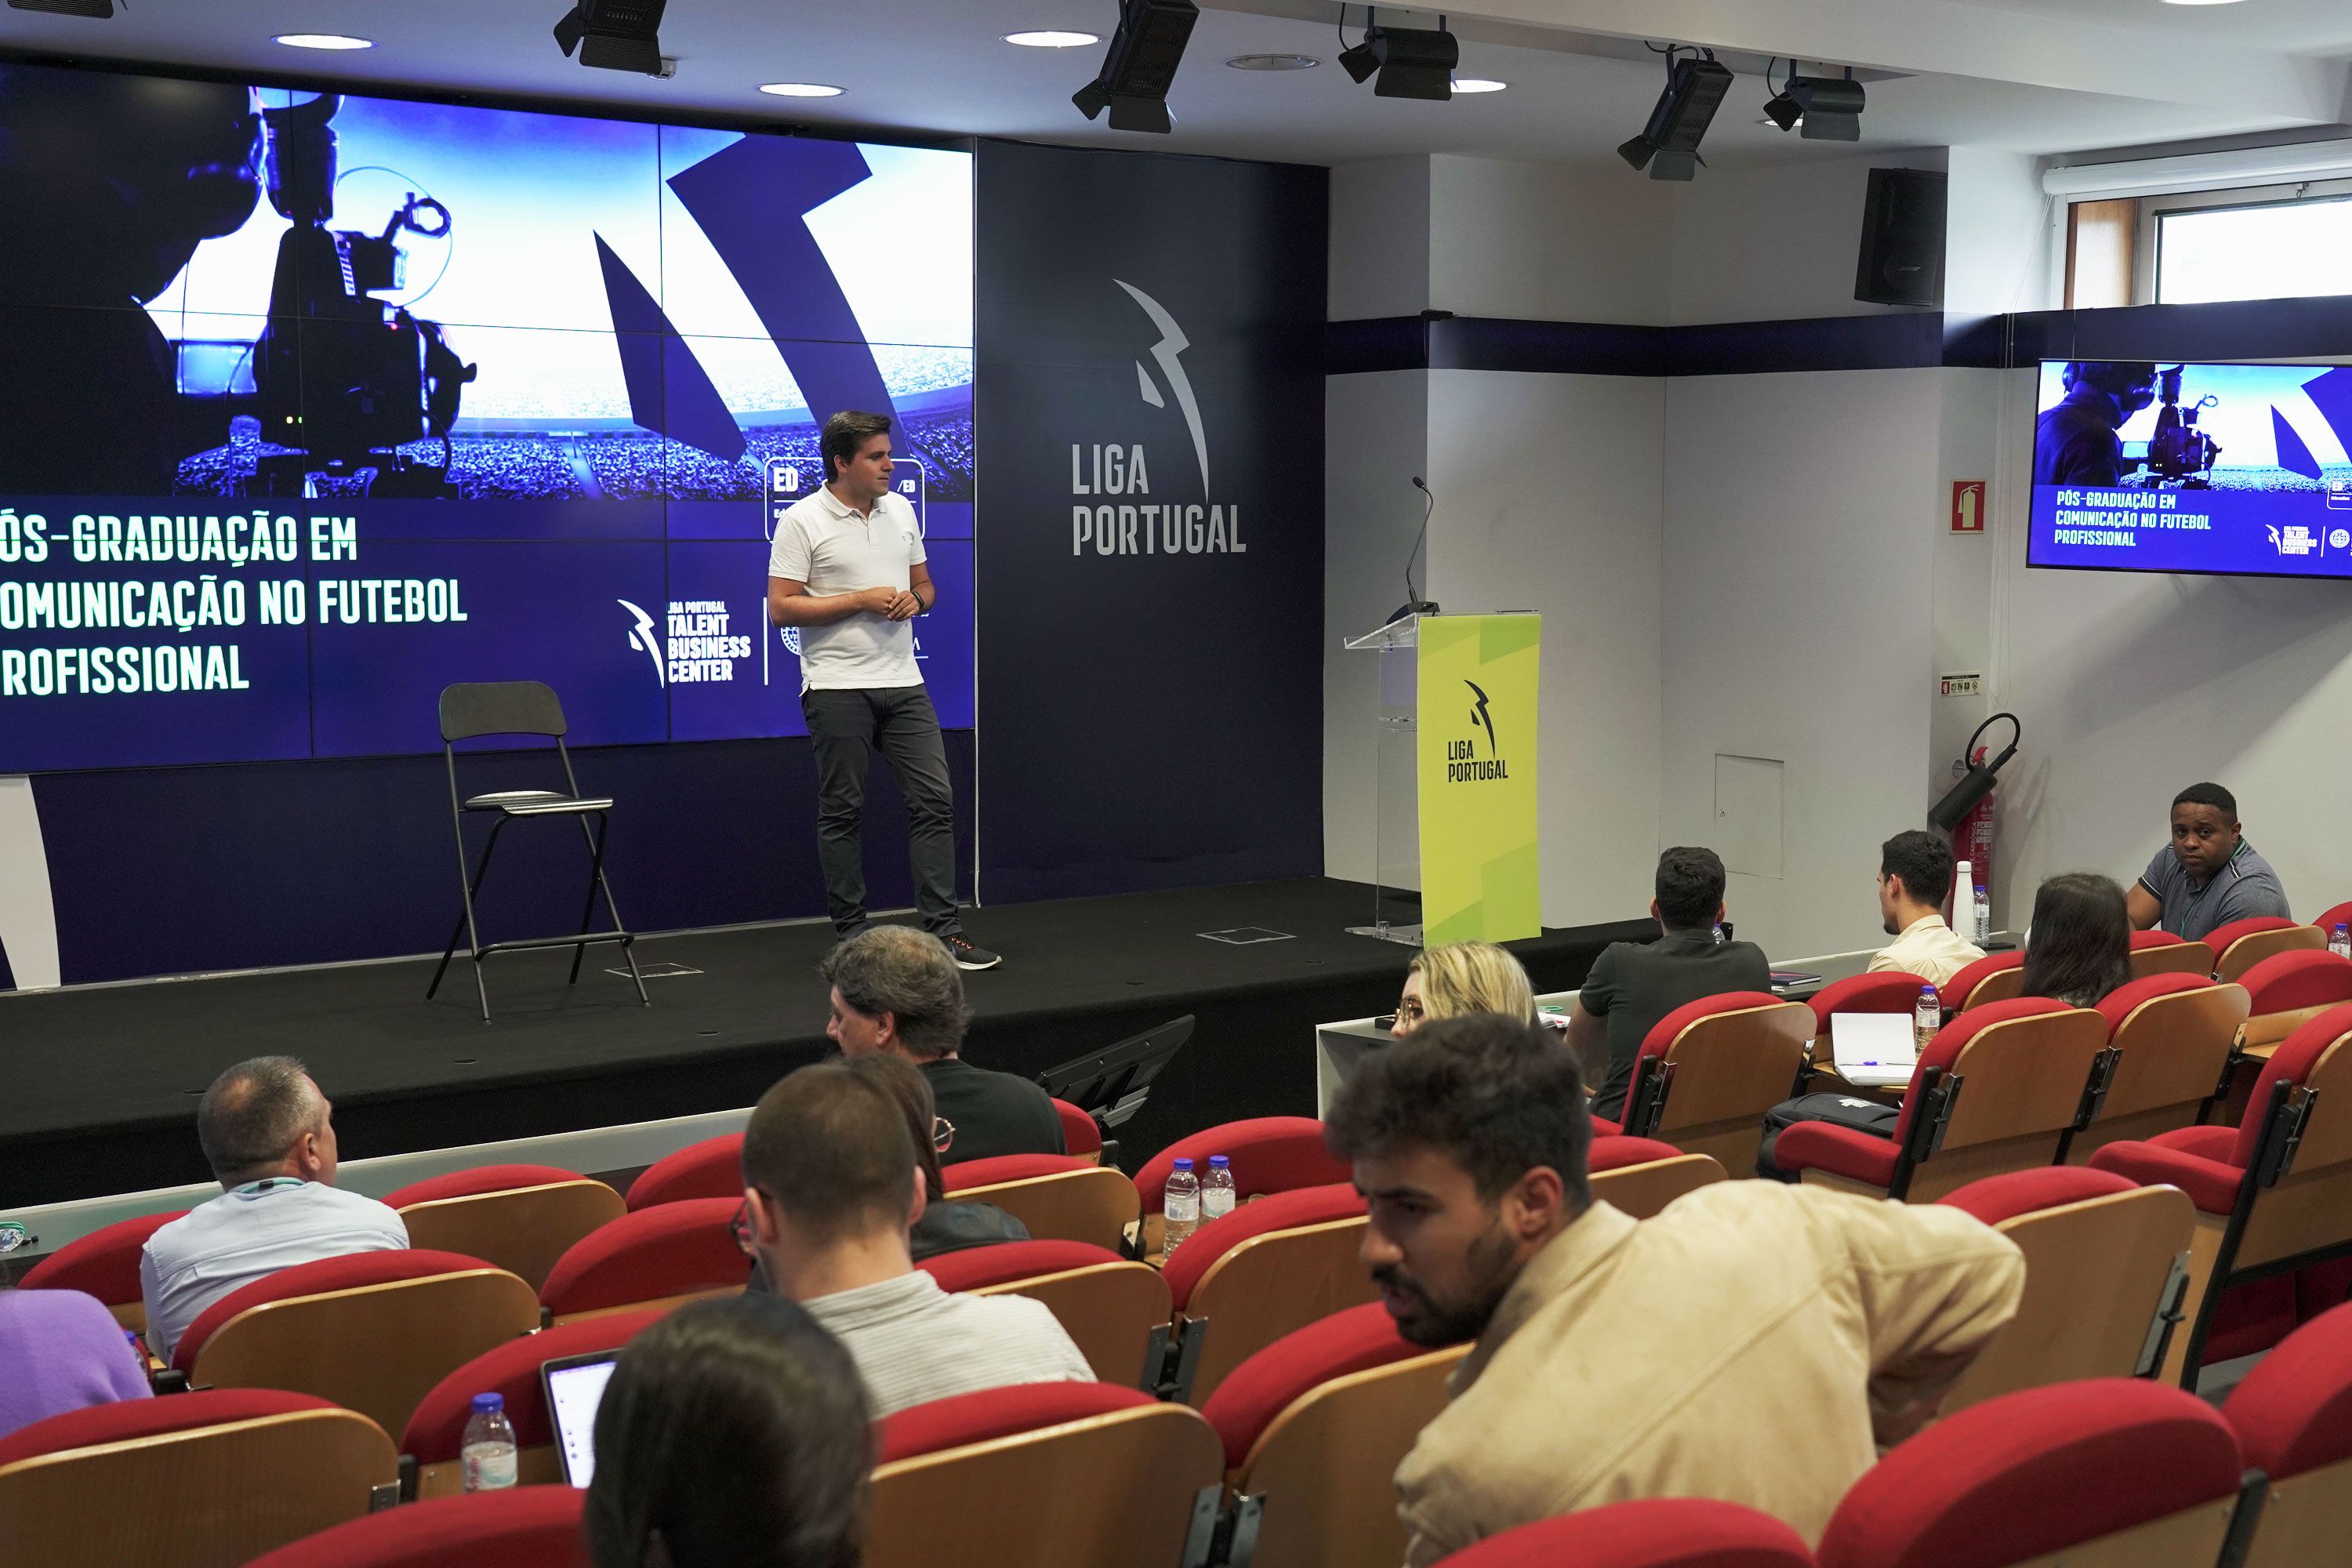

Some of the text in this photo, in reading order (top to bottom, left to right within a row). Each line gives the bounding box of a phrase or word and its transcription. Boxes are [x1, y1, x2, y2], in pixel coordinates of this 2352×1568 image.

[774, 467, 798, 492] ED
[1072, 444, 1149, 495] LIGA
[2056, 489, 2176, 510] PÓS-GRADUAÇÃO EM
[1073, 504, 1247, 556] PORTUGAL
[2056, 510, 2212, 530] COMUNICAÇÃO NO FUTEBOL
[310, 517, 358, 561] EM
[2054, 529, 2136, 546] PROFISSIONAL
[259, 579, 306, 626] NO
[318, 578, 468, 624] FUTEBOL
[684, 601, 727, 614] PORTUGAL
[668, 614, 730, 637] TALENT
[667, 636, 751, 659] BUSINESS
[668, 659, 733, 683] CENTER
[1448, 739, 1474, 761] LIGA
[1448, 760, 1508, 783] PORTUGAL
